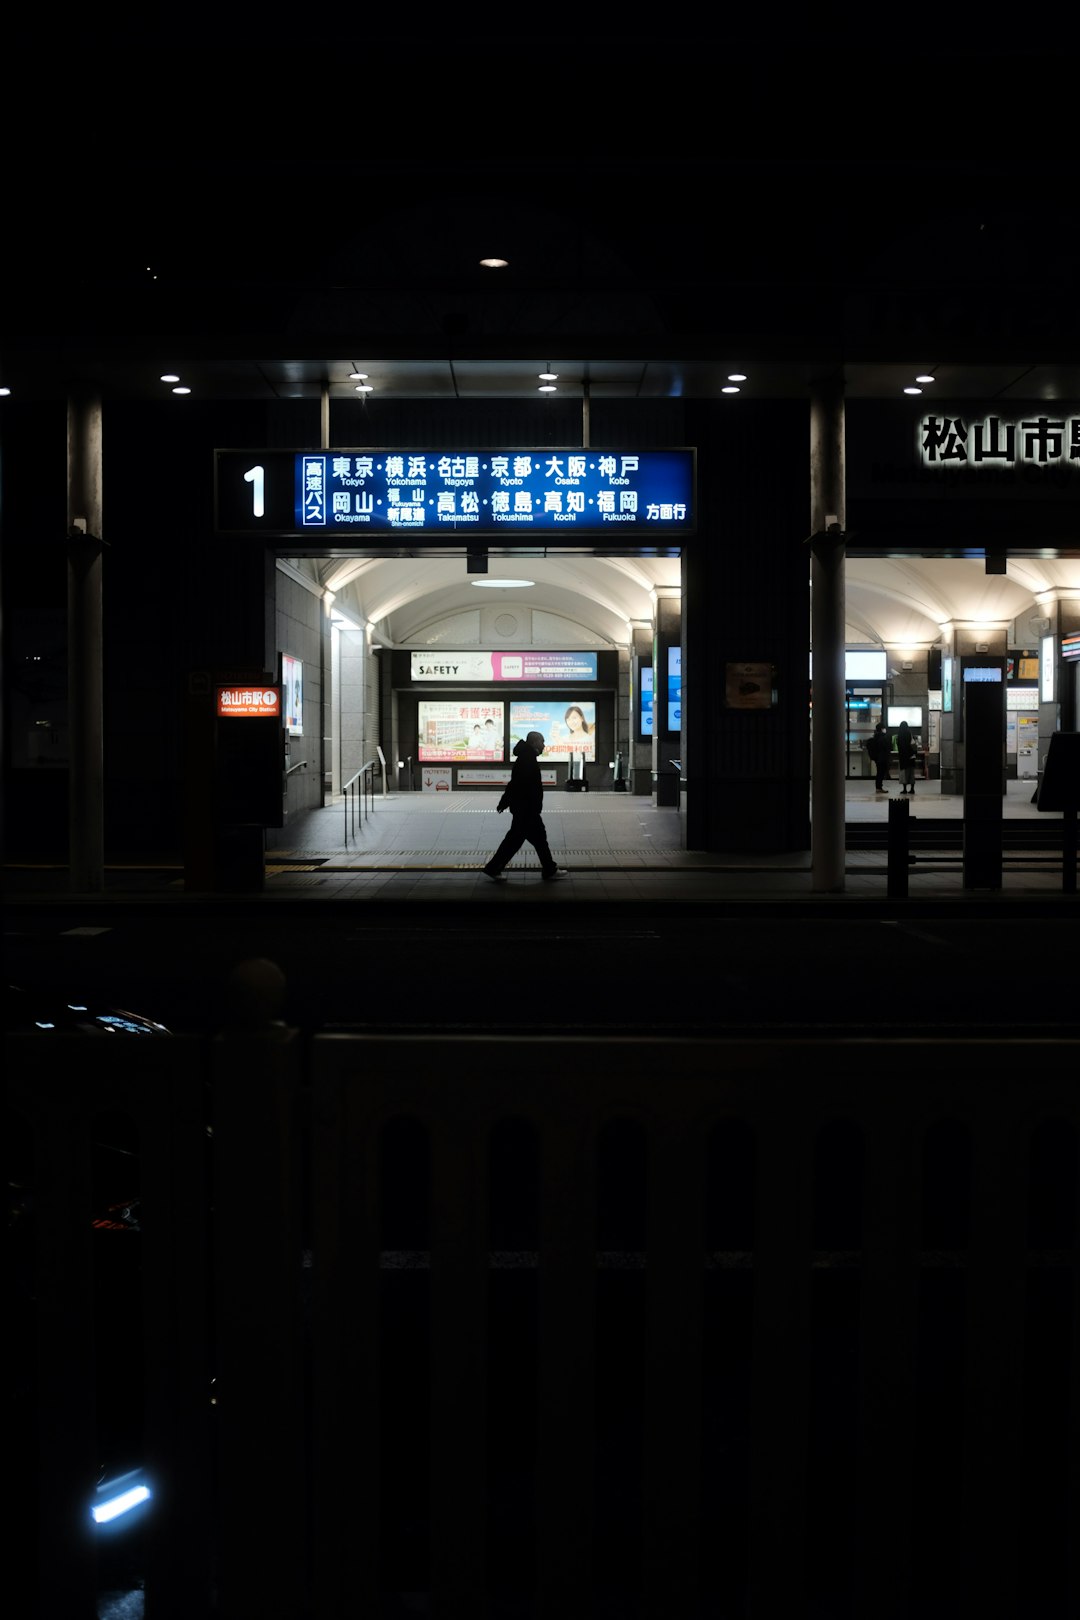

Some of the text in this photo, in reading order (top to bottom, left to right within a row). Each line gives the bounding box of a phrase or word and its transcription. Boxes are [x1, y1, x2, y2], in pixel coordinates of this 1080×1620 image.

[922, 416, 1080, 461] 松山市
[341, 477, 630, 487] Tokyo Yokohama Nagoya Kyoto Osaka Kobe
[244, 466, 264, 517] 1
[306, 462, 322, 519] 高速バス
[335, 513, 371, 522] Okayama
[437, 513, 479, 521] Takamatsu
[492, 513, 533, 521] Tokushima
[553, 513, 576, 521] Kochi
[603, 513, 636, 521] Fukuoka
[387, 507, 425, 521] 新尾道
[646, 504, 686, 520] 方面行
[419, 666, 459, 674] SAFETY
[459, 707, 502, 719] 看護学科
